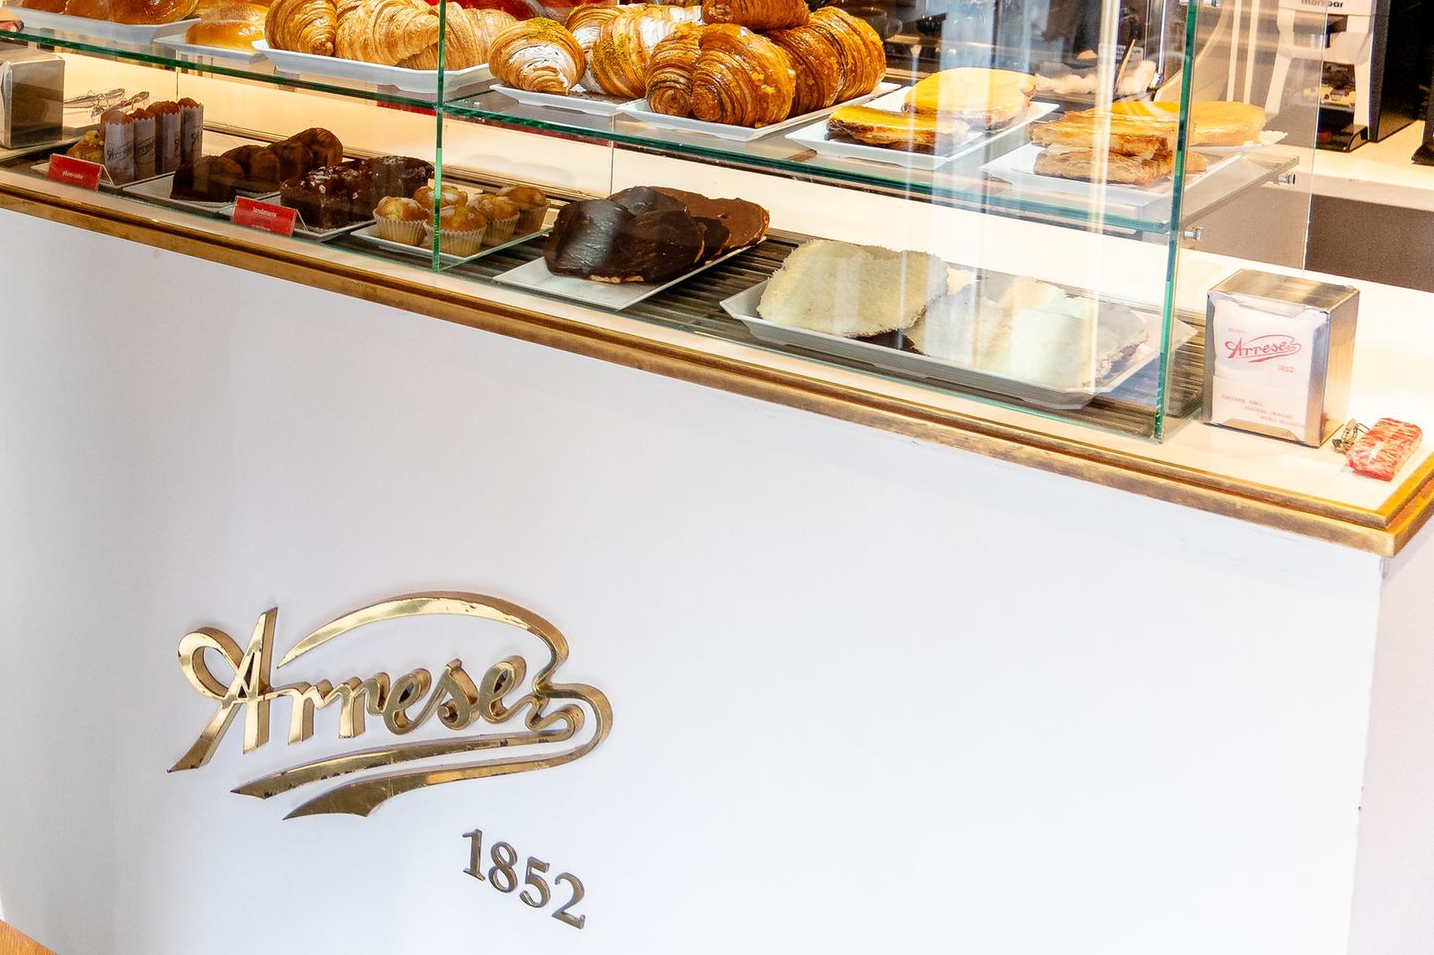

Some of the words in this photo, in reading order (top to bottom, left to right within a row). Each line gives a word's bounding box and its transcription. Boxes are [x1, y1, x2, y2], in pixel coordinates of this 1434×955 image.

[1224, 334, 1302, 363] Arrese
[167, 593, 610, 812] Arrese
[461, 828, 588, 931] 1852
